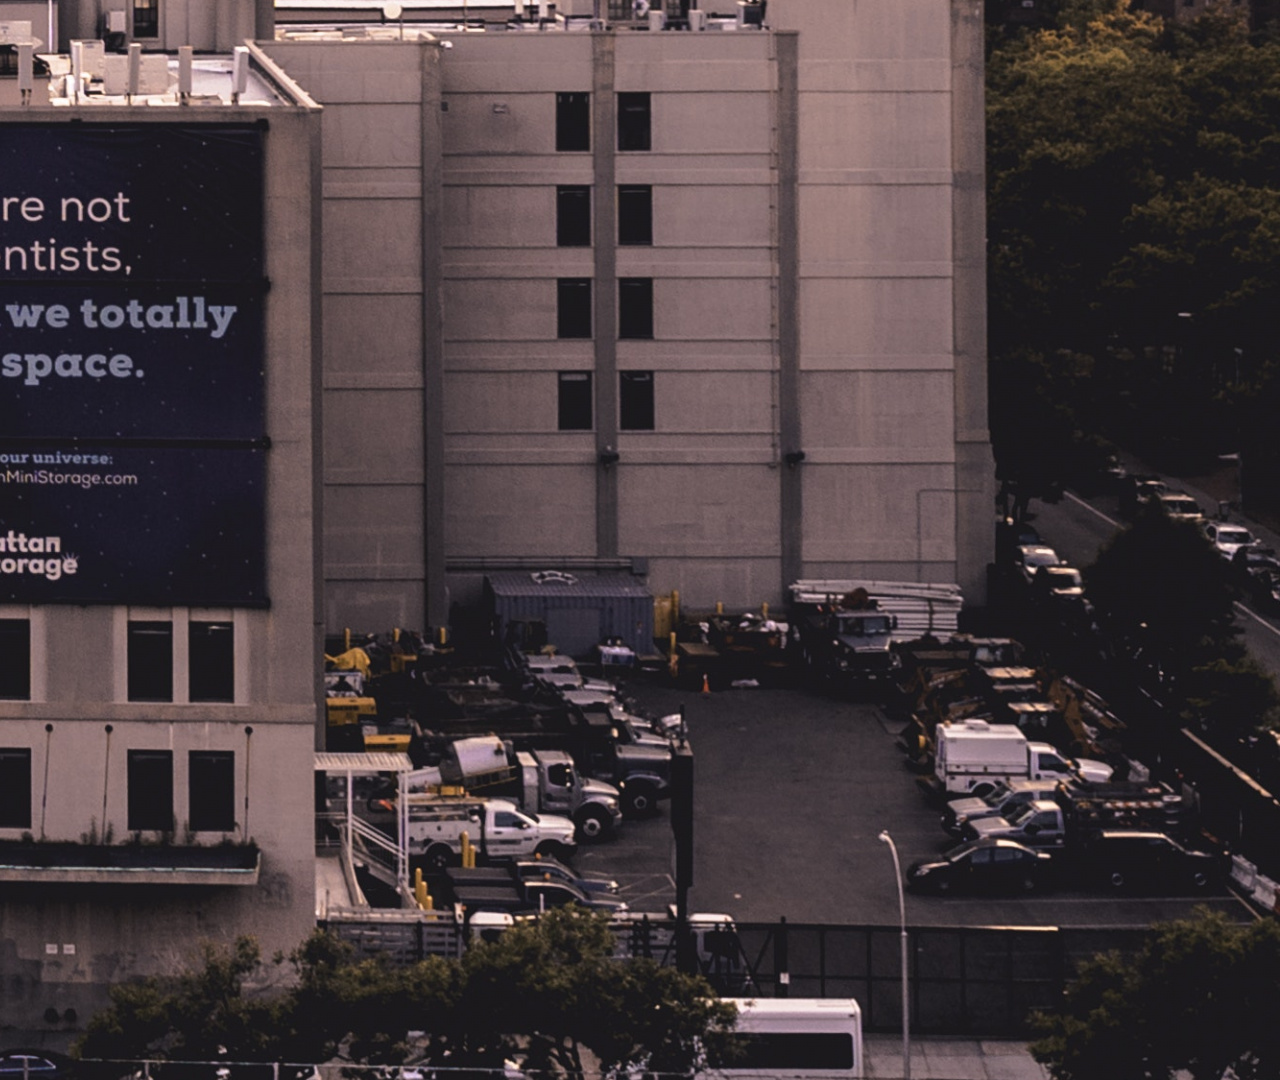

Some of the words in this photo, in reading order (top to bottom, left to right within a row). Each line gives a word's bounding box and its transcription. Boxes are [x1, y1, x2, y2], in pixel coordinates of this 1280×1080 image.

[60, 191, 131, 223] not
[4, 303, 71, 332] we
[79, 296, 238, 339] totally
[1, 348, 145, 386] space.
[32, 452, 113, 466] universe:
